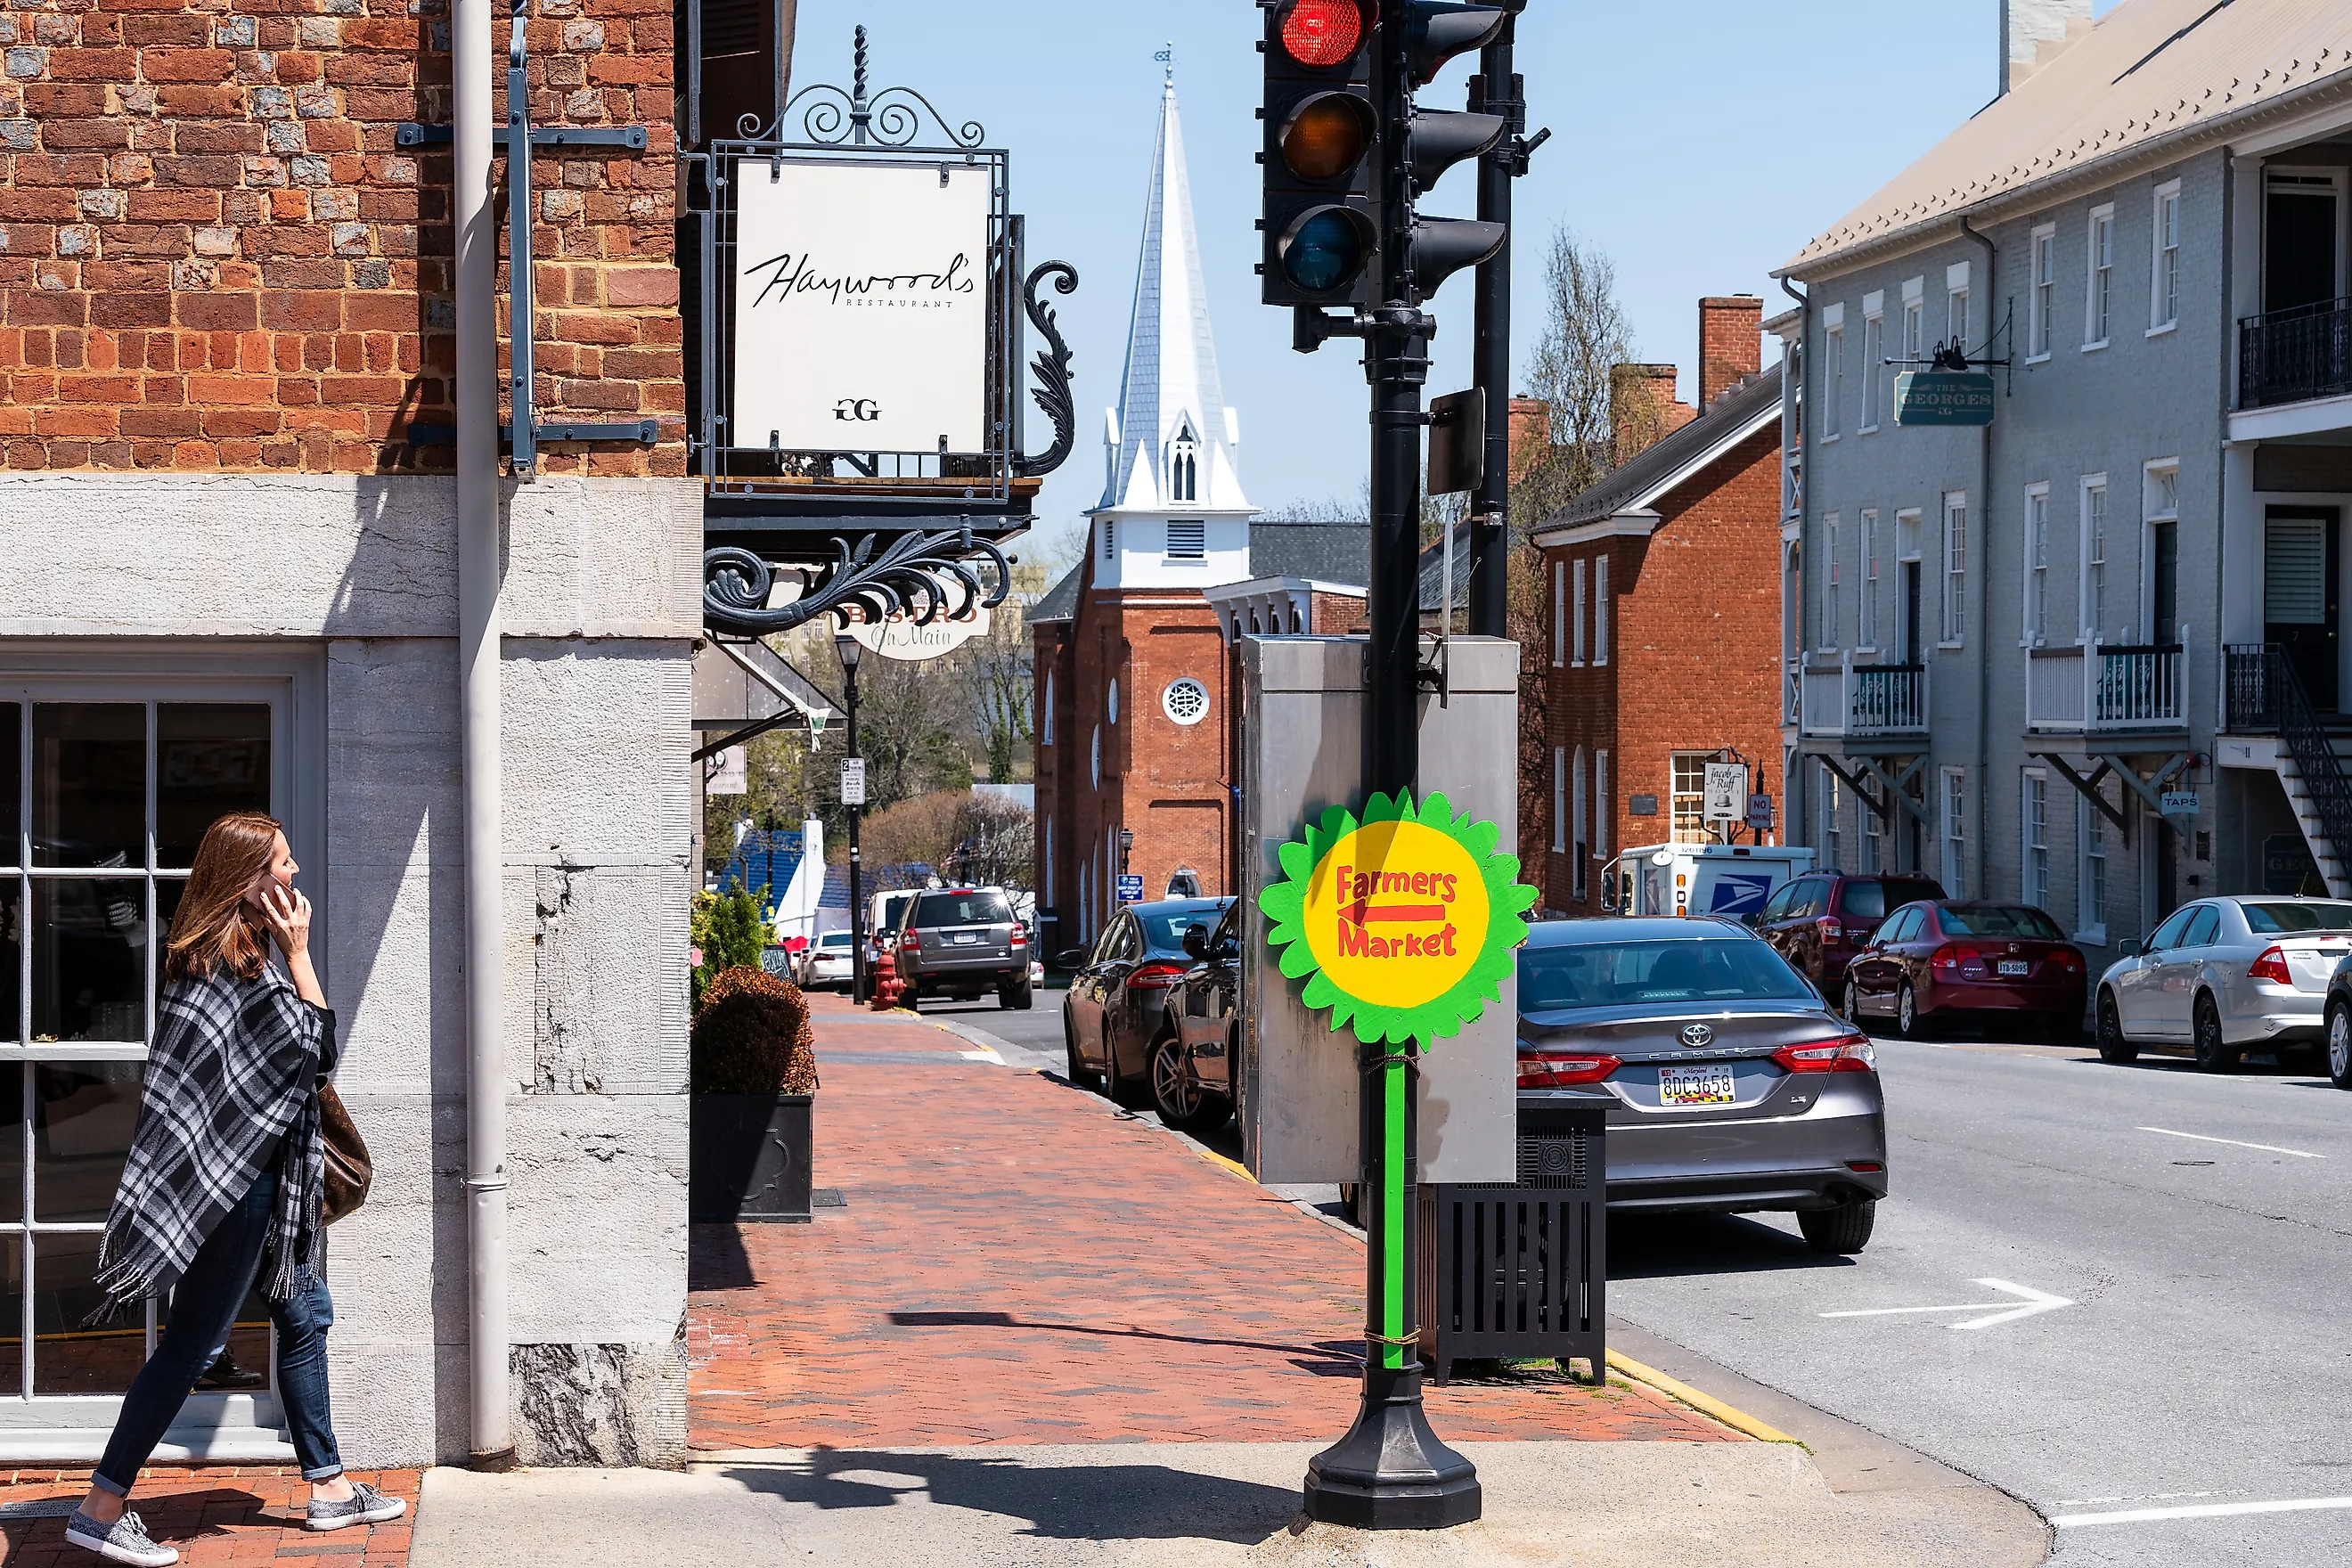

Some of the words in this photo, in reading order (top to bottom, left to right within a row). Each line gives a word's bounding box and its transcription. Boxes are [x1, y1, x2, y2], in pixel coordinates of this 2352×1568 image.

[743, 252, 974, 308] Haywood's
[845, 298, 953, 308] RESTAURANT
[1937, 384, 1956, 392] THE
[1899, 393, 1991, 405] GEORGES
[843, 606, 978, 624] BSTRO
[870, 625, 895, 648] On
[897, 626, 951, 647] Main
[843, 760, 849, 771] 2
[1706, 764, 1734, 786] Jacob
[1712, 772, 1743, 794] Ruff
[1753, 800, 1767, 809] NO
[2164, 798, 2199, 806] TAPS
[1336, 865, 1458, 904] Farmers
[1337, 917, 1458, 959] Market
[1648, 1049, 1749, 1060] CAMRY
[1663, 1074, 1731, 1096] 8DC3658
